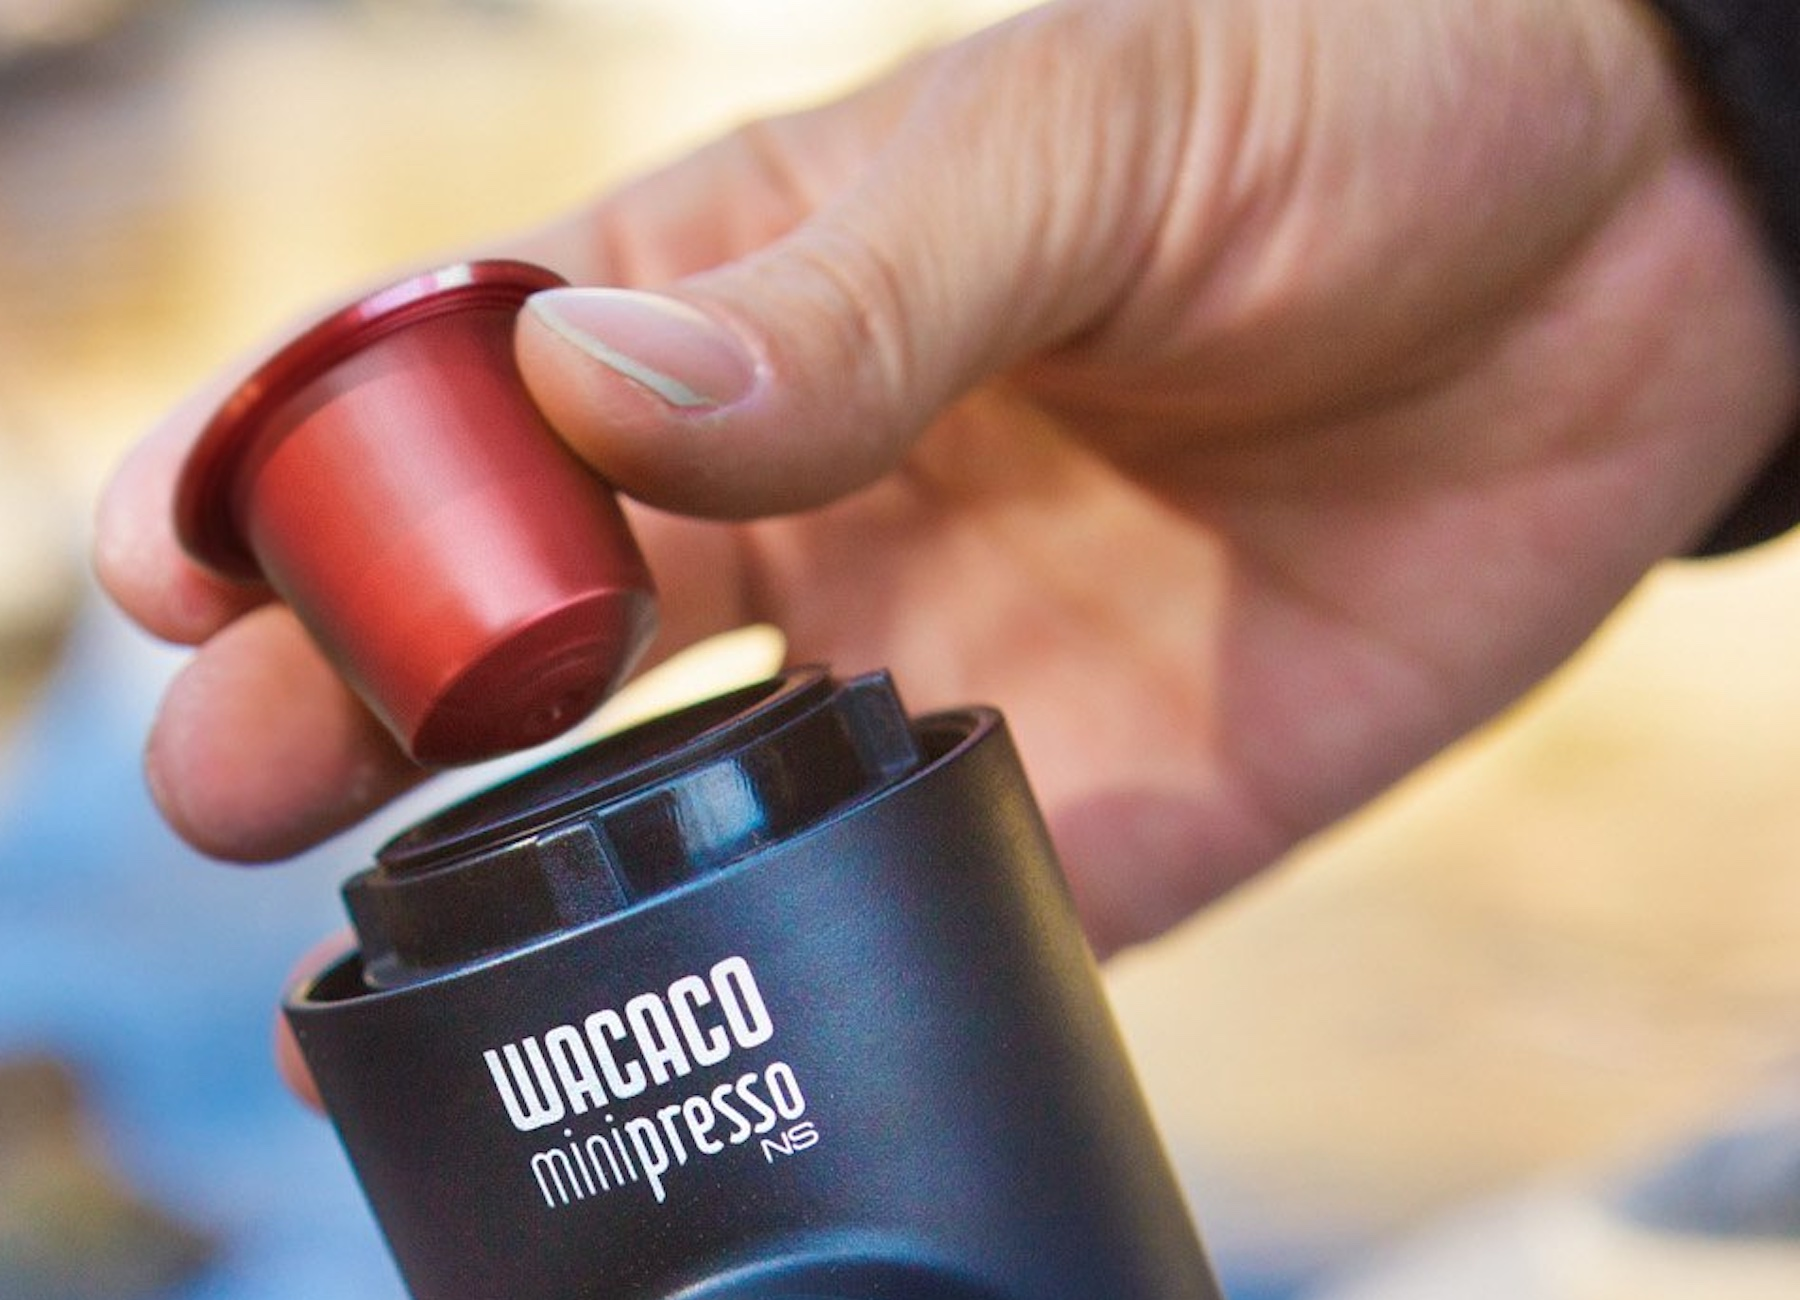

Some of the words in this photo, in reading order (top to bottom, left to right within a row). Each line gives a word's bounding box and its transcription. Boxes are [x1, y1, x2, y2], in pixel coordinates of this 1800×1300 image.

[483, 955, 774, 1132] WACACO
[531, 1061, 806, 1208] minipresso
[759, 1120, 820, 1164] NS
